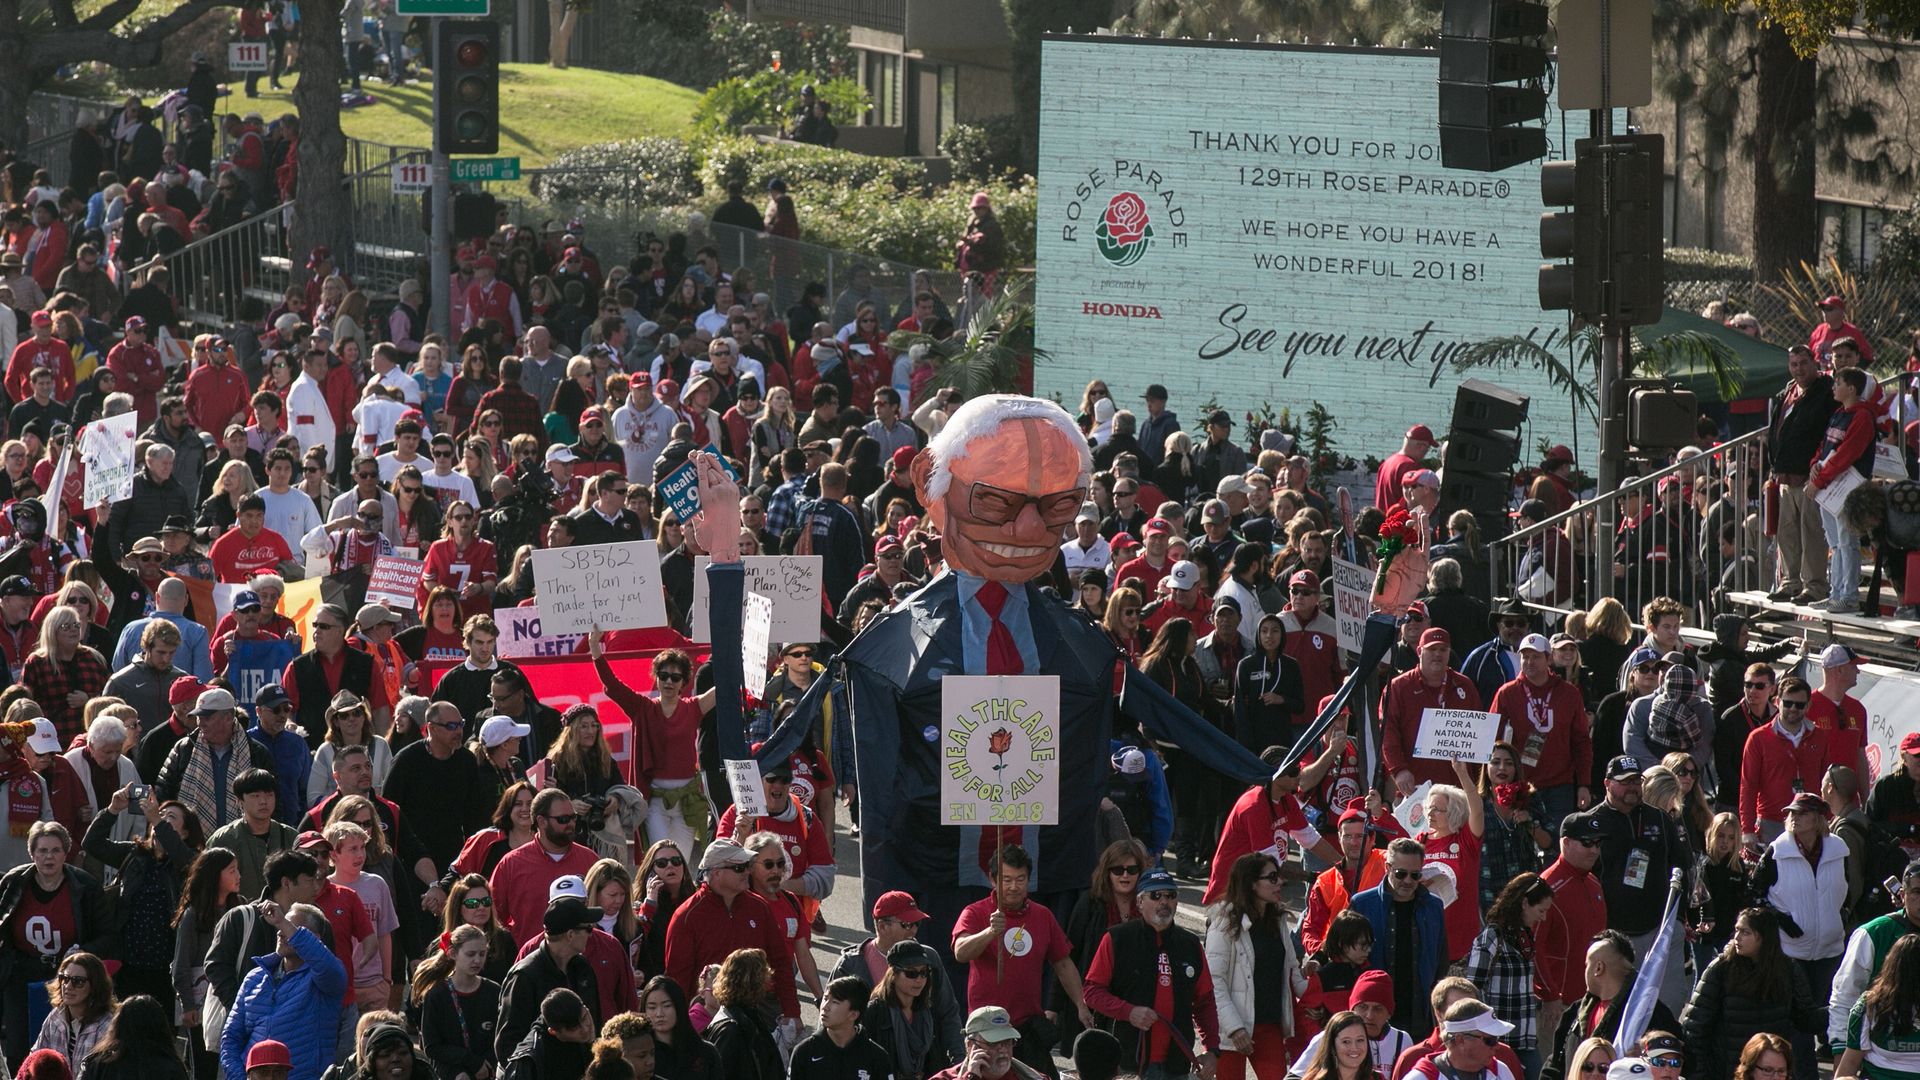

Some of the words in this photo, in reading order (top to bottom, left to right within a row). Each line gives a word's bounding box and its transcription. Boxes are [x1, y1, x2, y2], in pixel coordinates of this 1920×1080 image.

[237, 46, 260, 61] 111
[1189, 130, 1279, 152] THANK
[1288, 135, 1340, 156] YOU
[1352, 142, 1396, 159] FOR
[1405, 144, 1440, 161] JOI
[401, 166, 426, 182] 111
[456, 160, 494, 178] Green
[1240, 167, 1311, 189] 129TH
[1323, 171, 1387, 192] ROSE
[1062, 168, 1105, 242] ROSE
[1116, 160, 1188, 248] PARADE
[1242, 218, 1276, 236] WE
[1288, 222, 1350, 240] HOPE
[1359, 225, 1404, 244] YOU
[1416, 228, 1477, 248] HAVE
[1486, 232, 1501, 248] A
[1254, 253, 1403, 278] WONDERFUL
[1412, 260, 1484, 282] 2018!
[1137, 280, 1148, 293] by
[1082, 302, 1163, 320] HONDA
[1198, 303, 1277, 360] See
[1282, 331, 1347, 379] you
[1354, 320, 1448, 369] next
[673, 497, 686, 510] for
[679, 506, 694, 518] the
[376, 558, 424, 574] Guaranteed
[561, 545, 634, 570] SB562
[766, 566, 776, 576] is
[788, 558, 813, 579] Single
[1334, 562, 1360, 590] BERNIE
[372, 570, 418, 586] Healthcare
[450, 564, 471, 592] 7
[542, 578, 578, 596] This
[584, 570, 620, 592] Plan
[632, 571, 648, 586] is
[384, 582, 415, 594] Californians
[592, 594, 612, 610] for
[619, 592, 642, 612] you
[1338, 588, 1367, 620] HEALTH
[572, 612, 594, 628] and
[513, 618, 542, 642] NO
[534, 638, 575, 656] LEFT
[1435, 710, 1488, 720] PHYSICIANS
[1446, 720, 1464, 728] FOR
[946, 698, 1056, 780] HEALTHCARE
[1434, 729, 1478, 740] NATIONAL
[1436, 740, 1472, 749] HEALTH
[1872, 714, 1898, 774] PARA
[1430, 748, 1476, 760] PROGRAM
[1620, 758, 1638, 766] SEC
[963, 776, 1004, 802] FOR
[1010, 768, 1044, 801] ALL
[950, 802, 977, 821] IN
[990, 802, 1044, 823] 2018
[556, 880, 574, 890] G
[25, 916, 62, 955] OU
[1630, 1064, 1646, 1074] G
